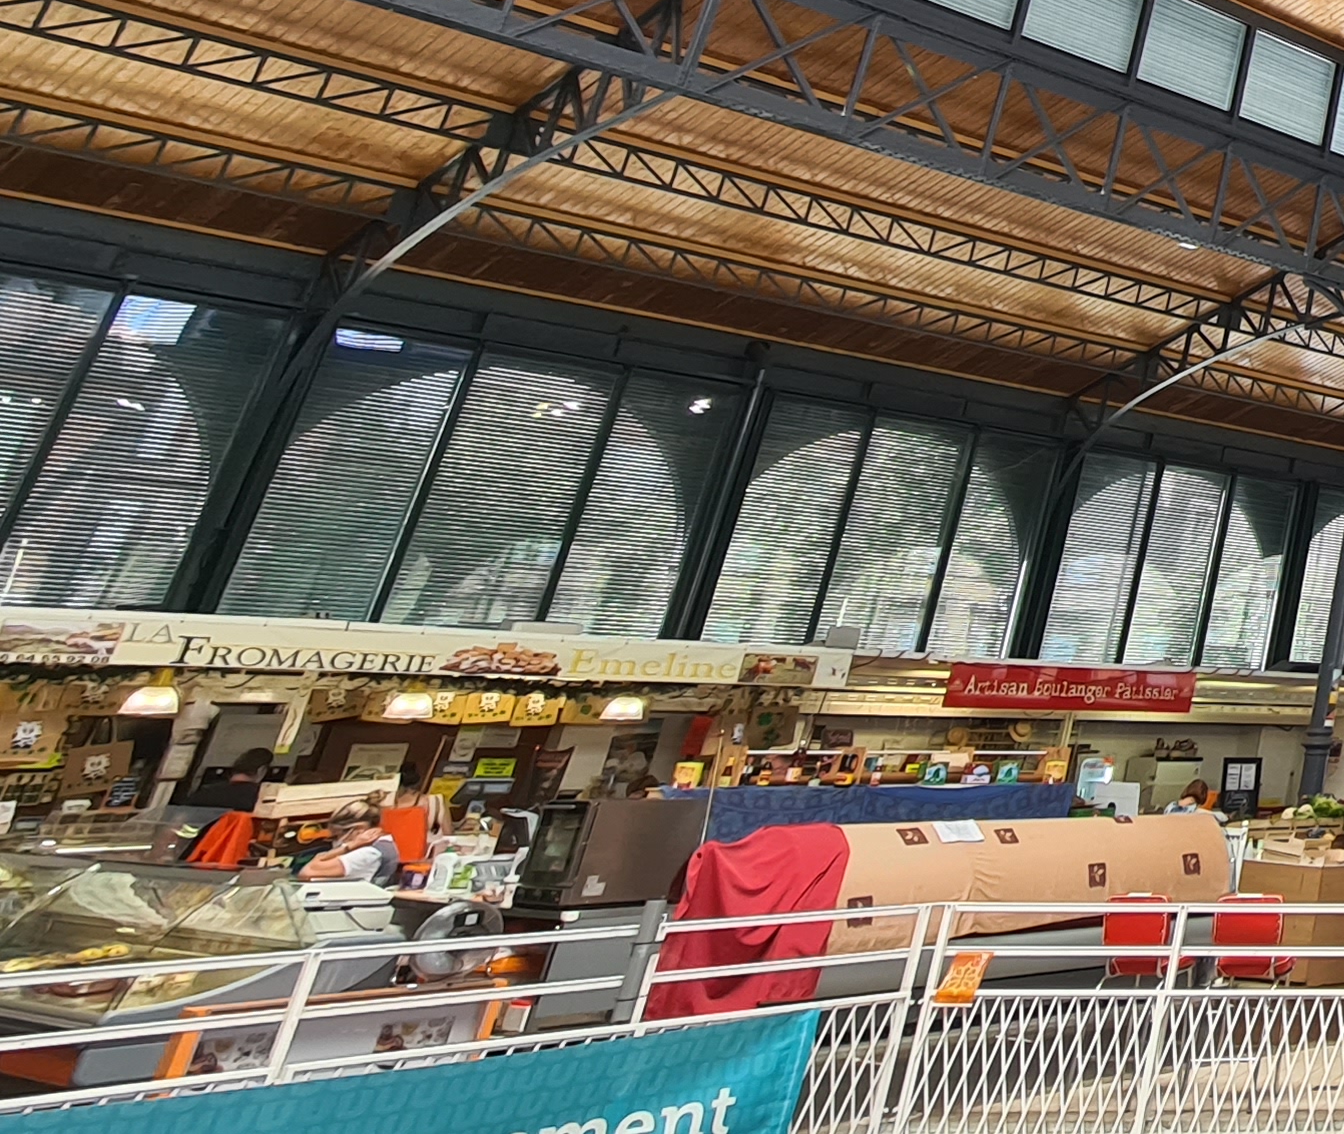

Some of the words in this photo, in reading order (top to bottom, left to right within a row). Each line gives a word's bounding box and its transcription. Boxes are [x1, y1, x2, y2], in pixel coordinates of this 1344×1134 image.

[126, 622, 176, 644] LA
[170, 635, 437, 673] FROMAGERIE
[568, 648, 737, 680] Emeline
[964, 674, 1028, 696] Artisan
[1034, 678, 1111, 703] Boulanger
